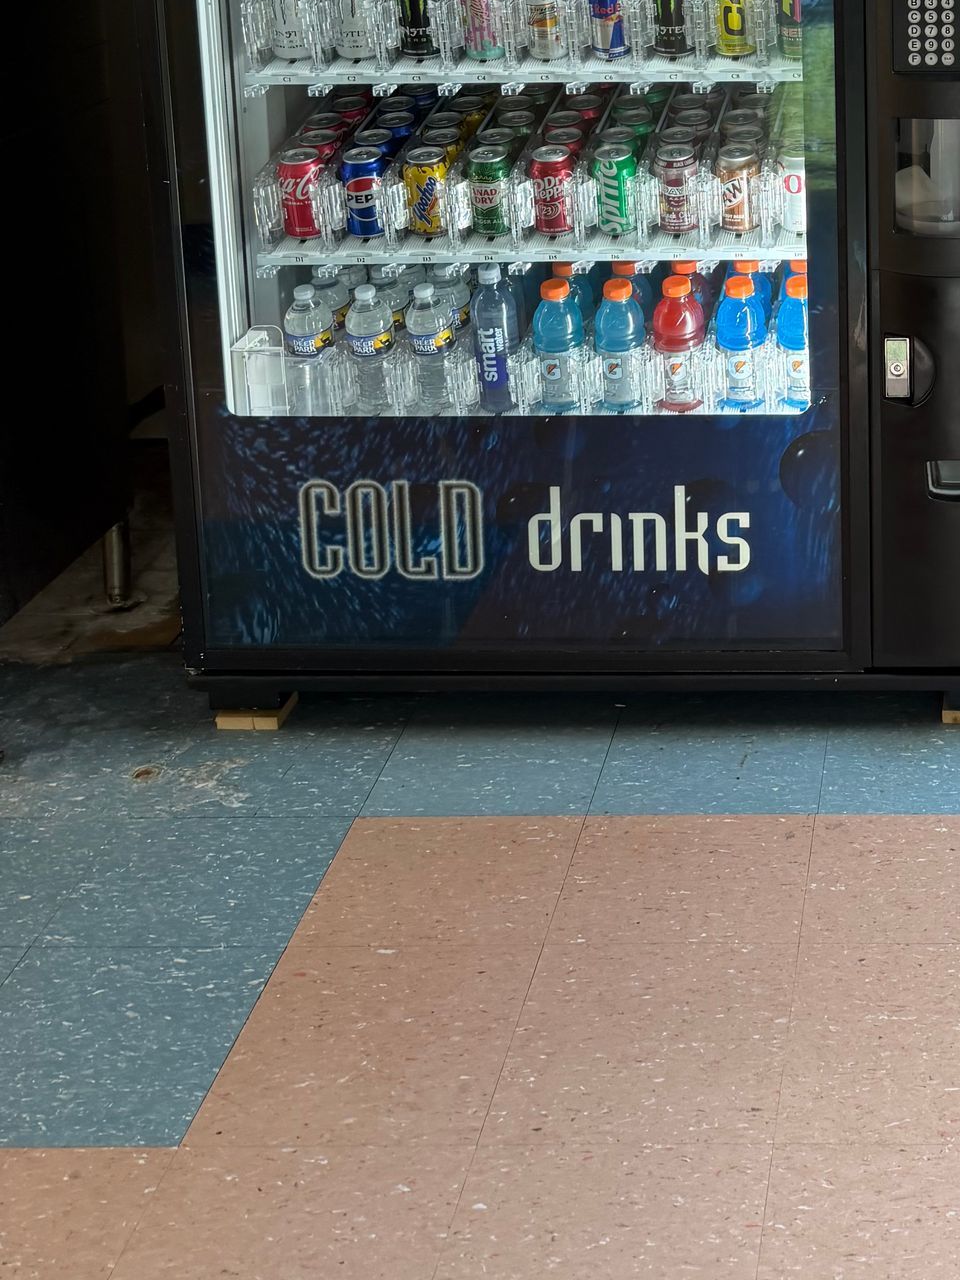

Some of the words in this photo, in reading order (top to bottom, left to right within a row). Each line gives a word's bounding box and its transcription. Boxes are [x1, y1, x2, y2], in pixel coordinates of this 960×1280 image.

[593, 4, 613, 15] Red
[475, 196, 495, 204] DRY
[601, 161, 623, 235] Sprite
[293, 338, 315, 348] DEER
[352, 339, 374, 348] DEER
[413, 338, 436, 347] DEER
[496, 327, 504, 352] water
[294, 345, 316, 354] PARK
[353, 346, 375, 355] PARK
[414, 345, 437, 353] PARK
[478, 327, 498, 382] smart
[300, 480, 486, 579] COLD
[527, 485, 751, 576] drinks
